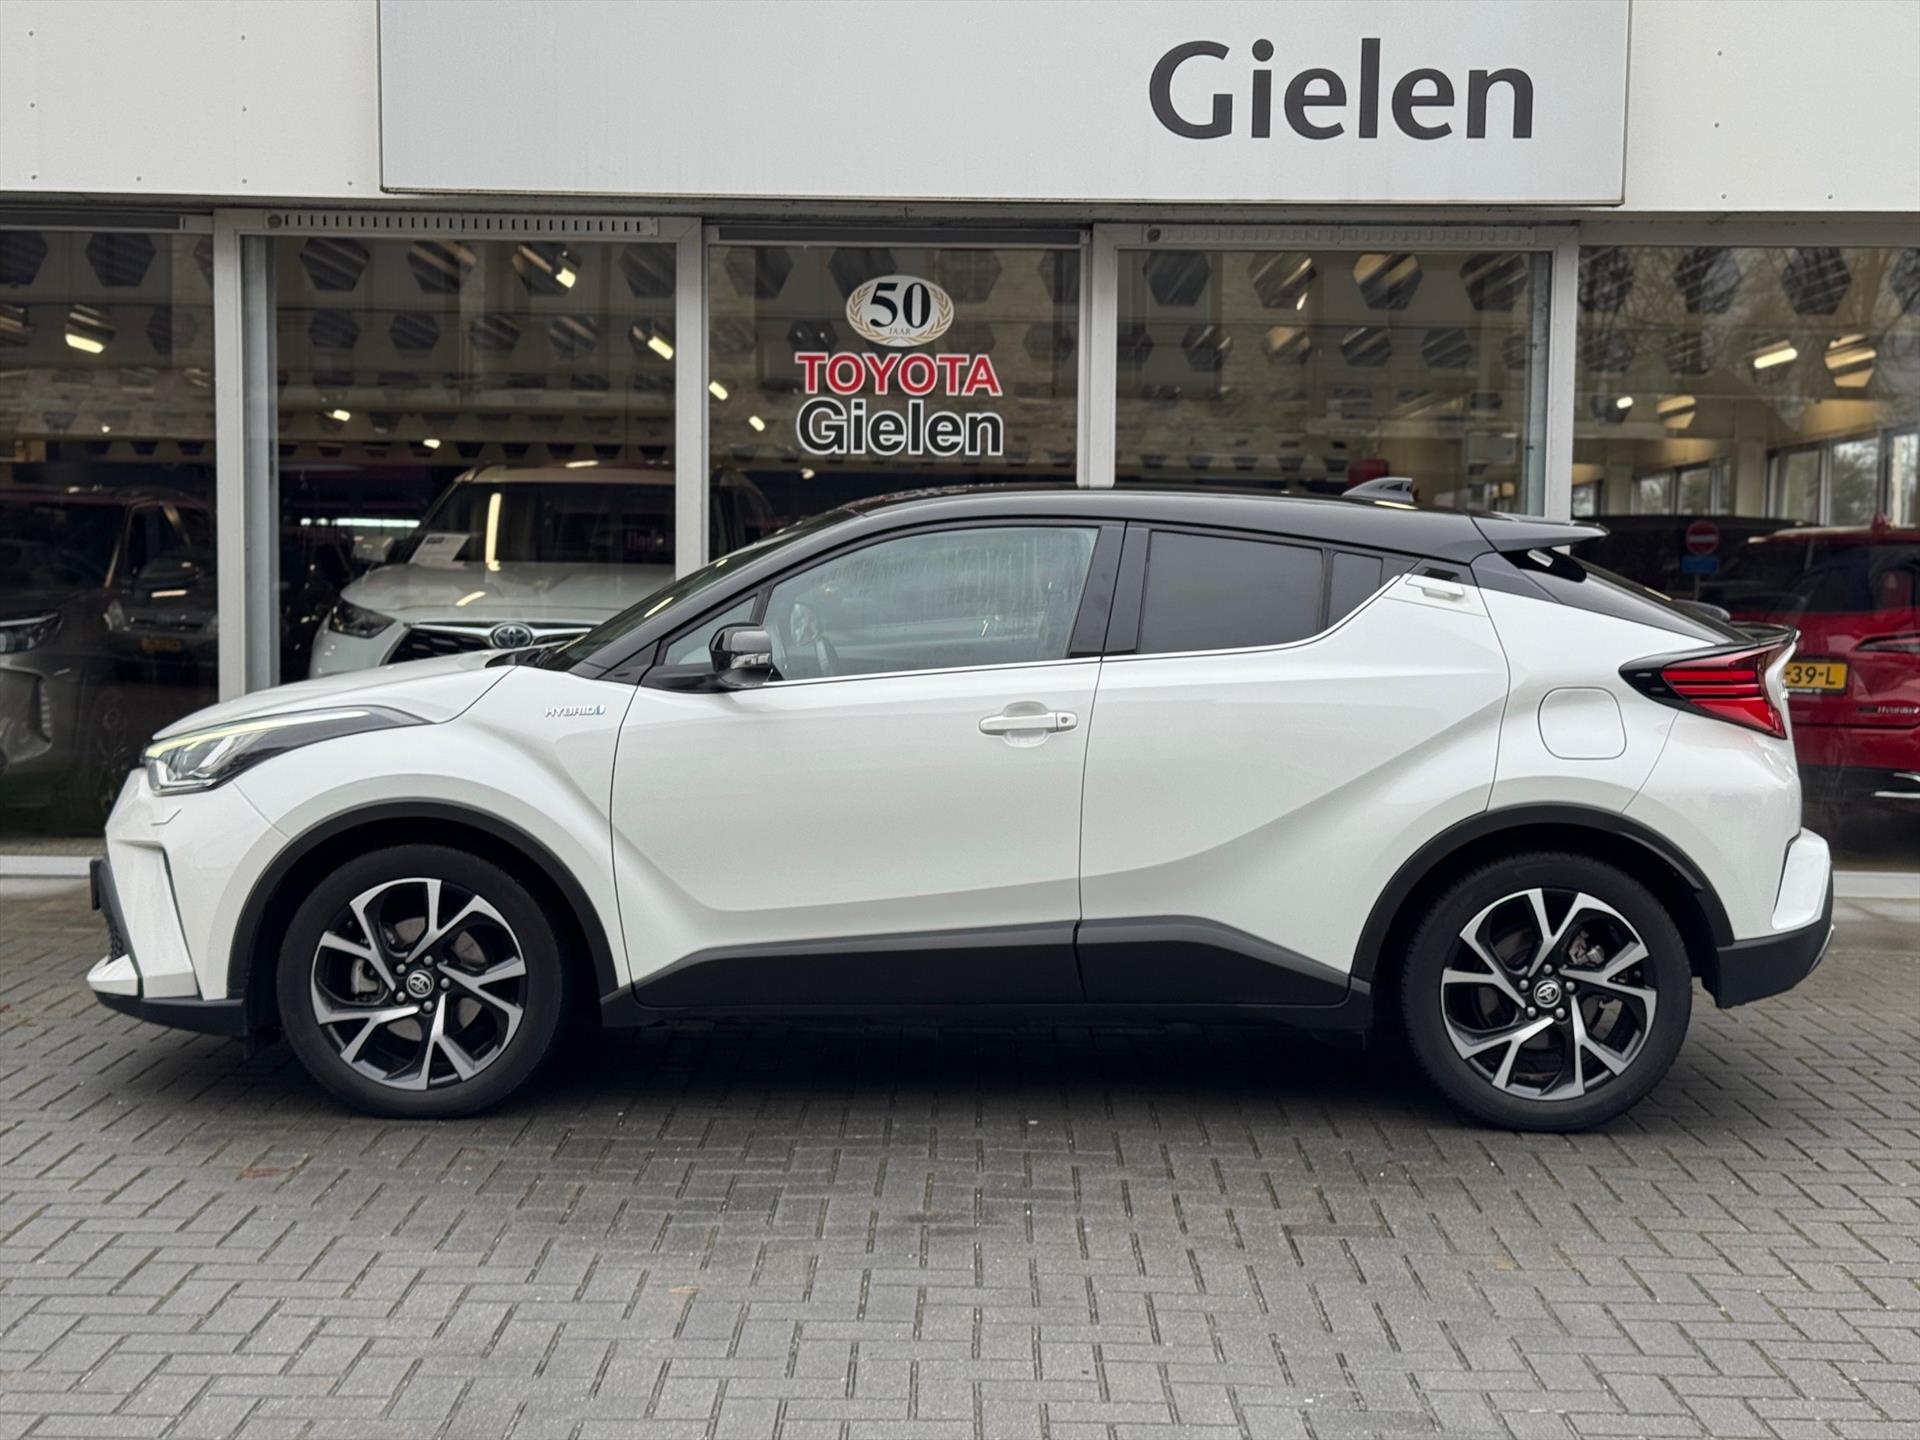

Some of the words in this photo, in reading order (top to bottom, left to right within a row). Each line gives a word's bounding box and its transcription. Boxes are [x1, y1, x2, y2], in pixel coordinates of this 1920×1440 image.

[1149, 38, 1534, 140] Gielen
[869, 282, 932, 329] 50
[795, 352, 1003, 396] TOYOTA
[796, 397, 1004, 456] Gielen
[545, 704, 596, 718] HYBRID
